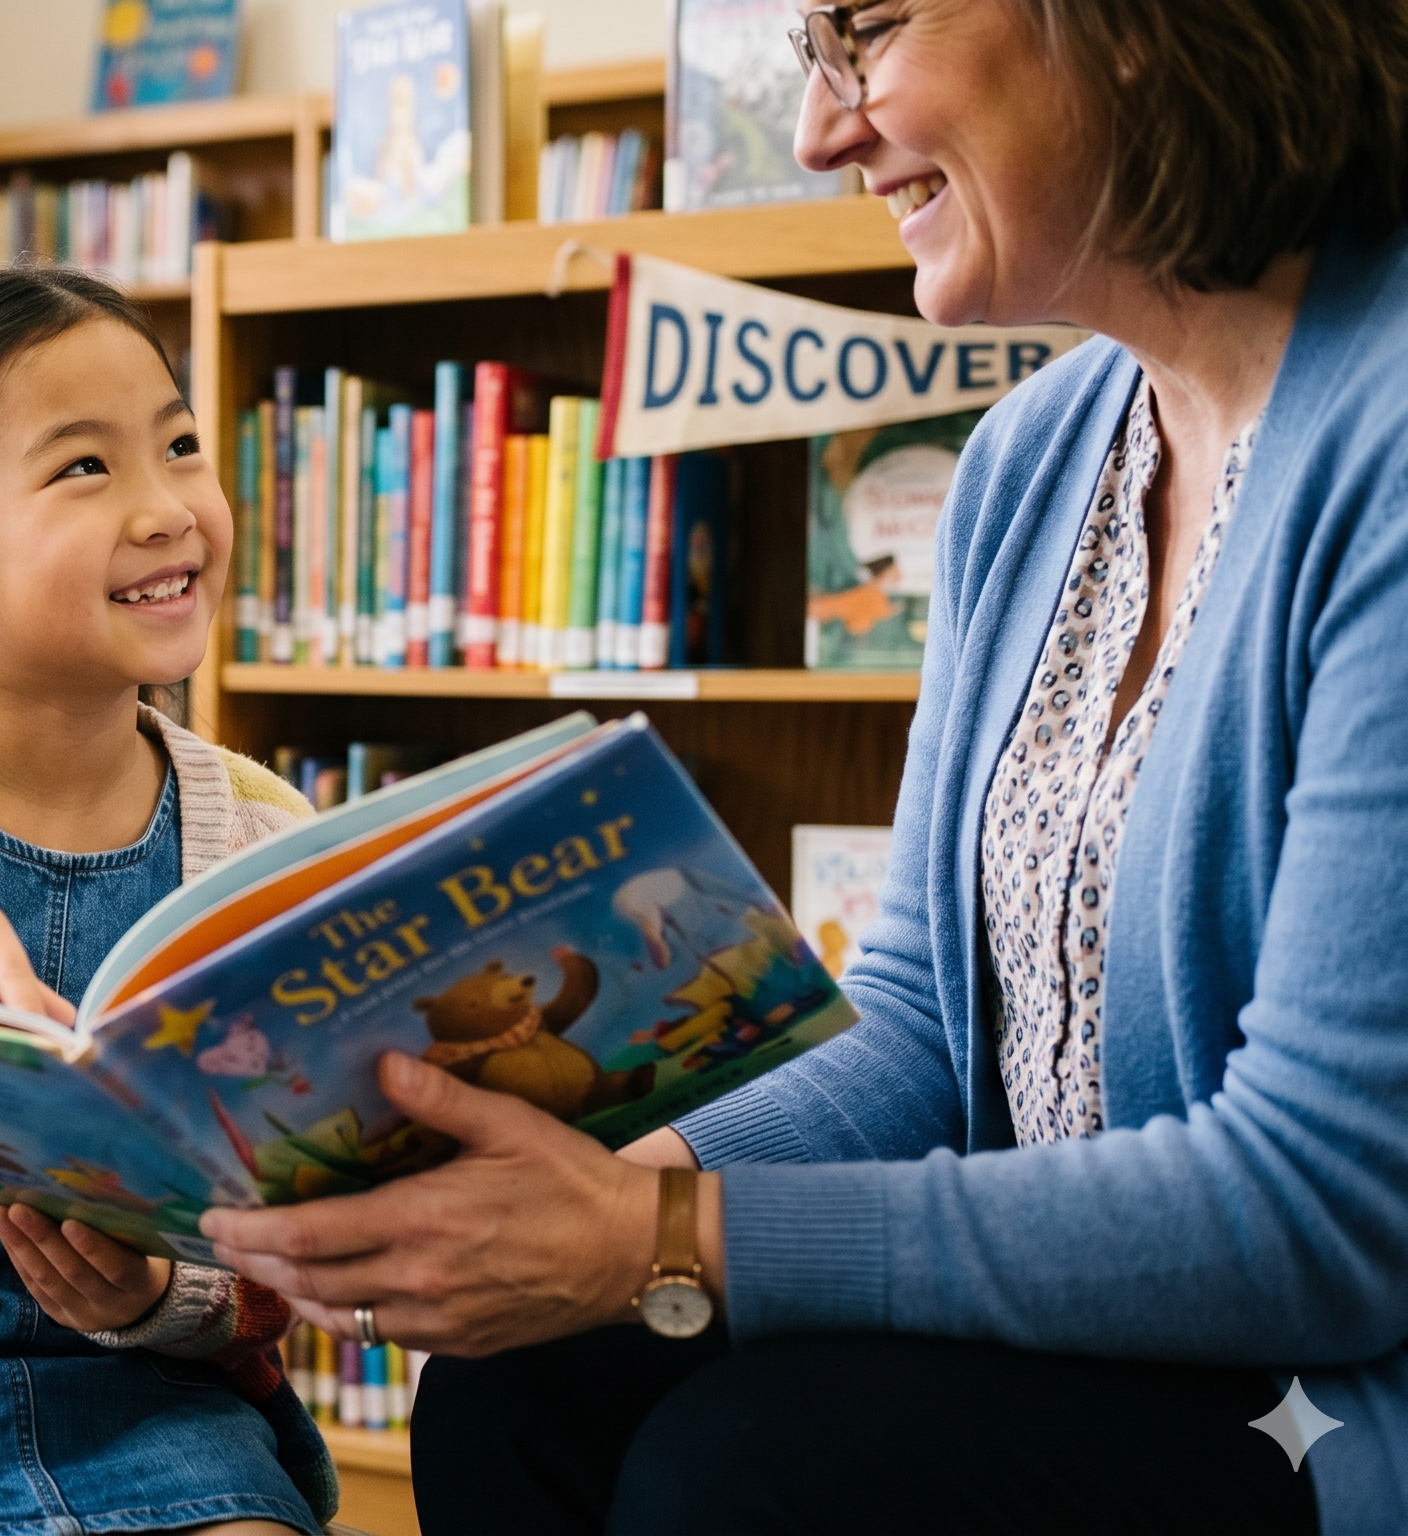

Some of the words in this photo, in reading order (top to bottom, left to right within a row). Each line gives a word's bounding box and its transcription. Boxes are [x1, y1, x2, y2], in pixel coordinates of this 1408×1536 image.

[643, 303, 1053, 408] DISCOVER
[270, 914, 432, 1026] Star
[436, 814, 634, 929] Bear
[308, 898, 400, 949] The
